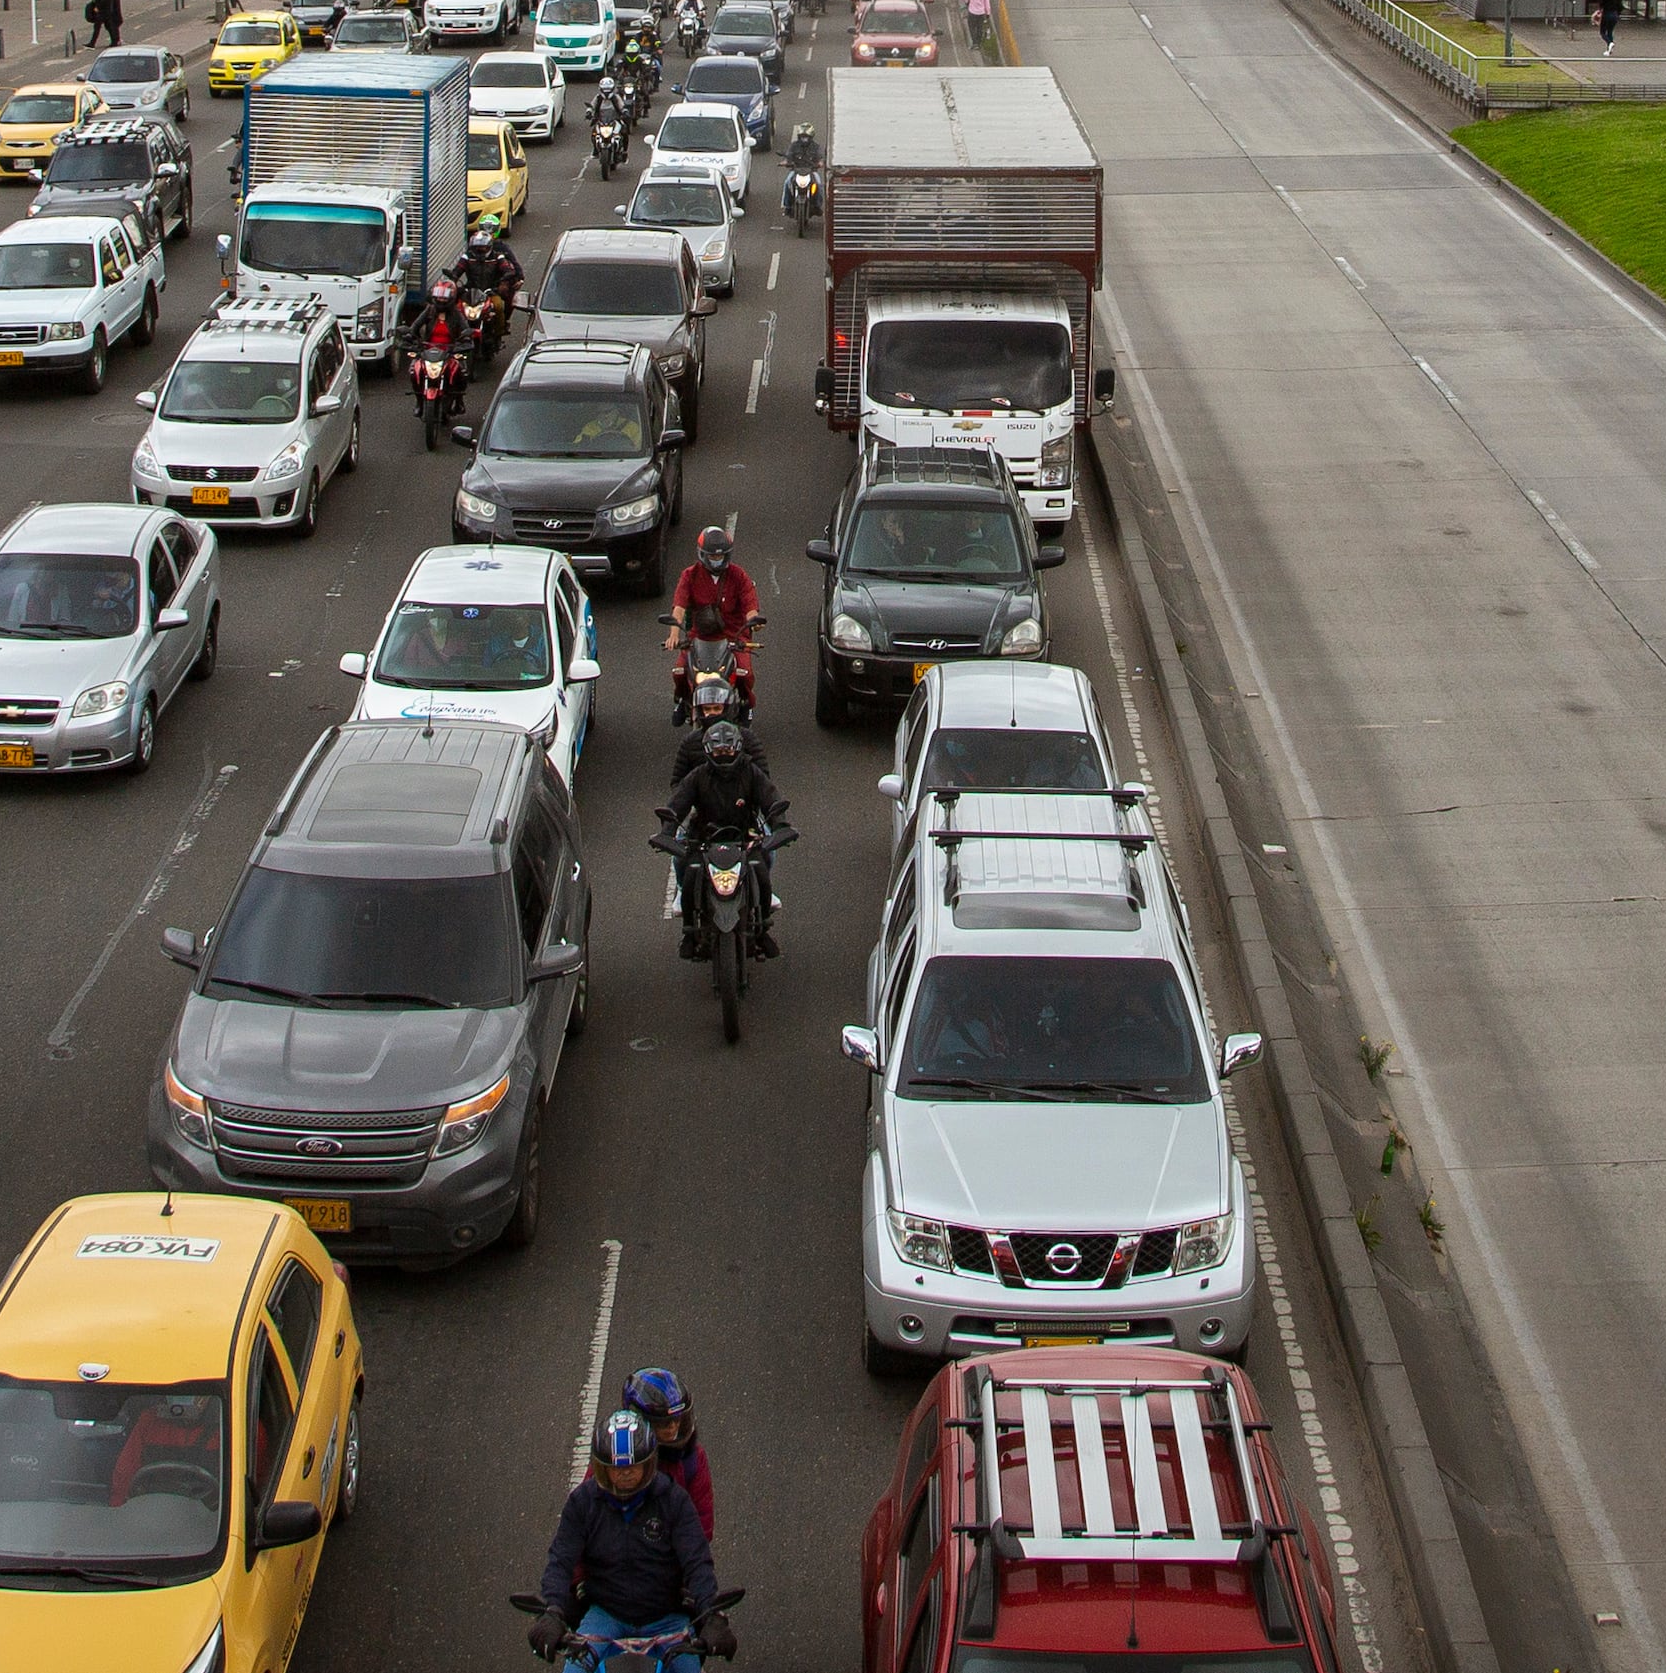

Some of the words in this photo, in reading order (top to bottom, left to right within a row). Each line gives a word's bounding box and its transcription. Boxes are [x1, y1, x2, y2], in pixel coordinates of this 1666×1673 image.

[683, 157, 724, 165] ADOM
[1006, 423, 1037, 431] ISUZU
[934, 435, 997, 444] CHEVROLET
[306, 1140, 332, 1153] Ford
